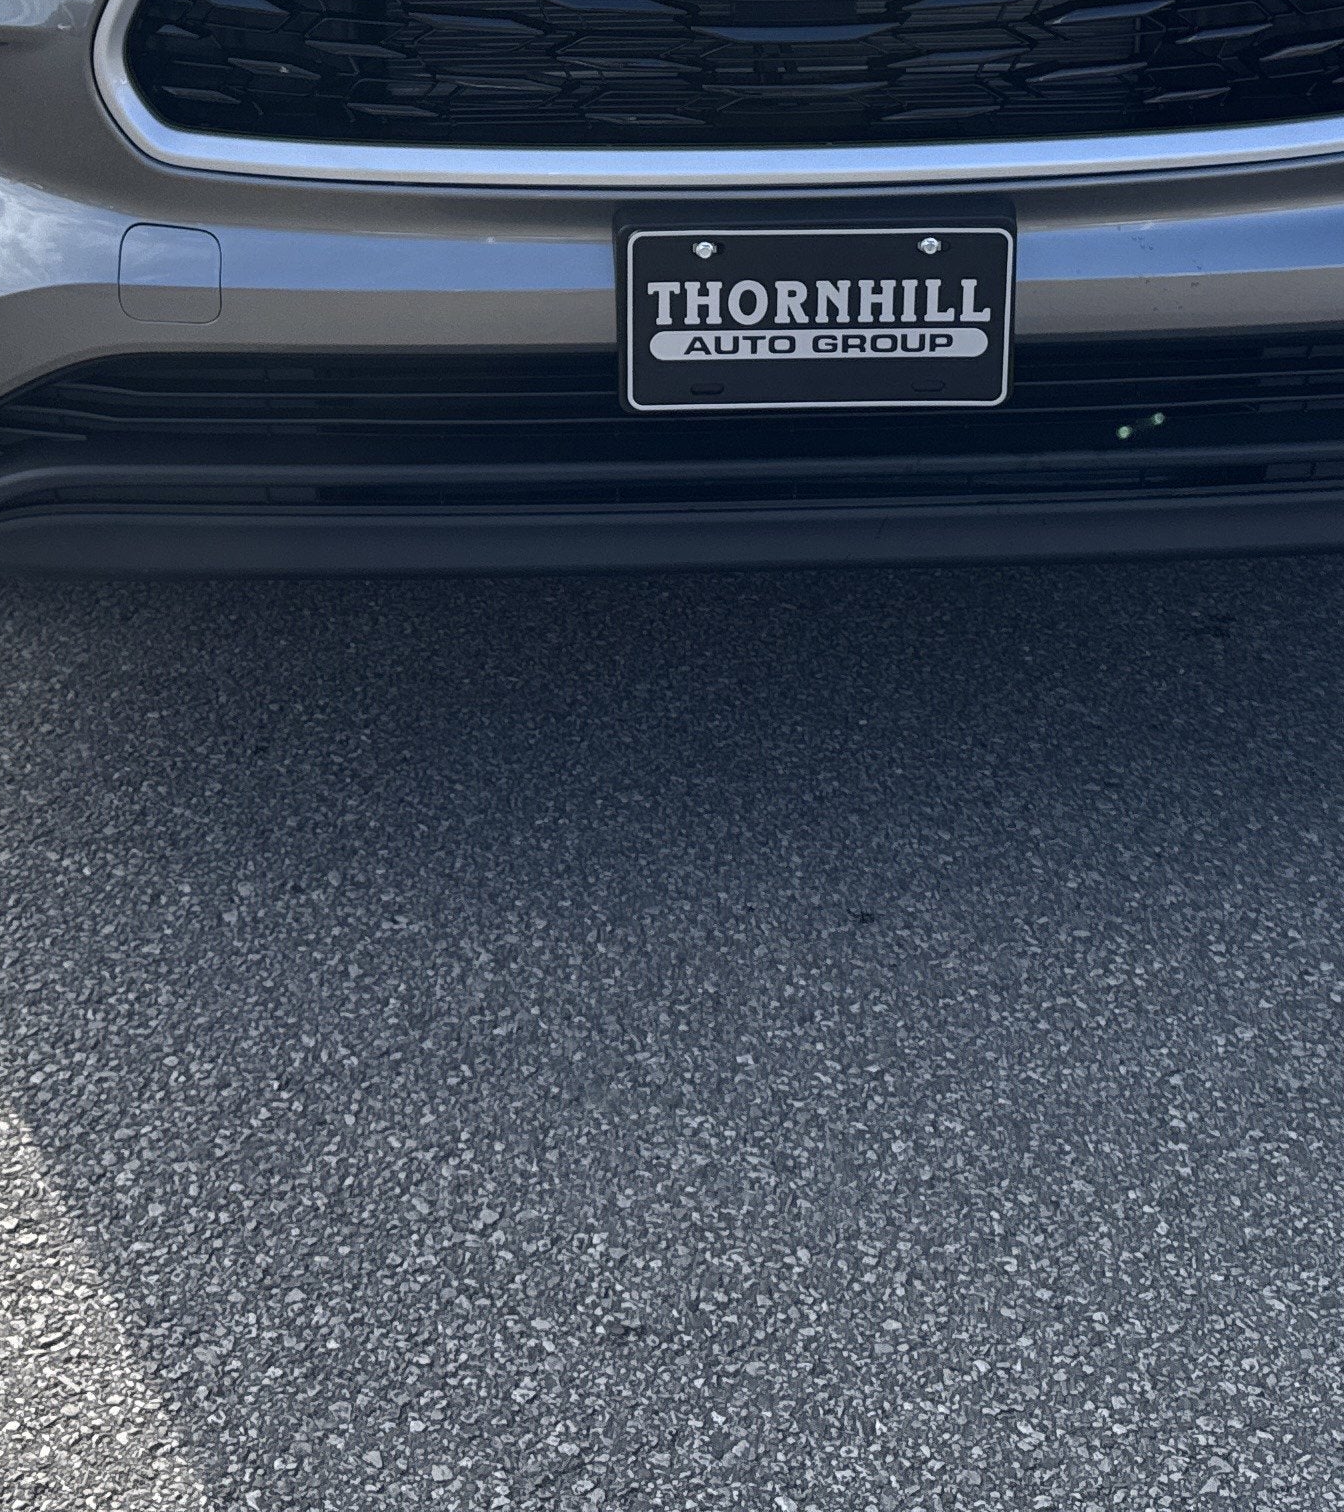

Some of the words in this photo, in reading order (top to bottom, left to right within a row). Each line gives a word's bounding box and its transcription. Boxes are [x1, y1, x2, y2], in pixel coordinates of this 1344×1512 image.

[647, 278, 991, 326] THORNHILL
[683, 334, 797, 356] AUTO
[811, 332, 954, 355] GROUP
